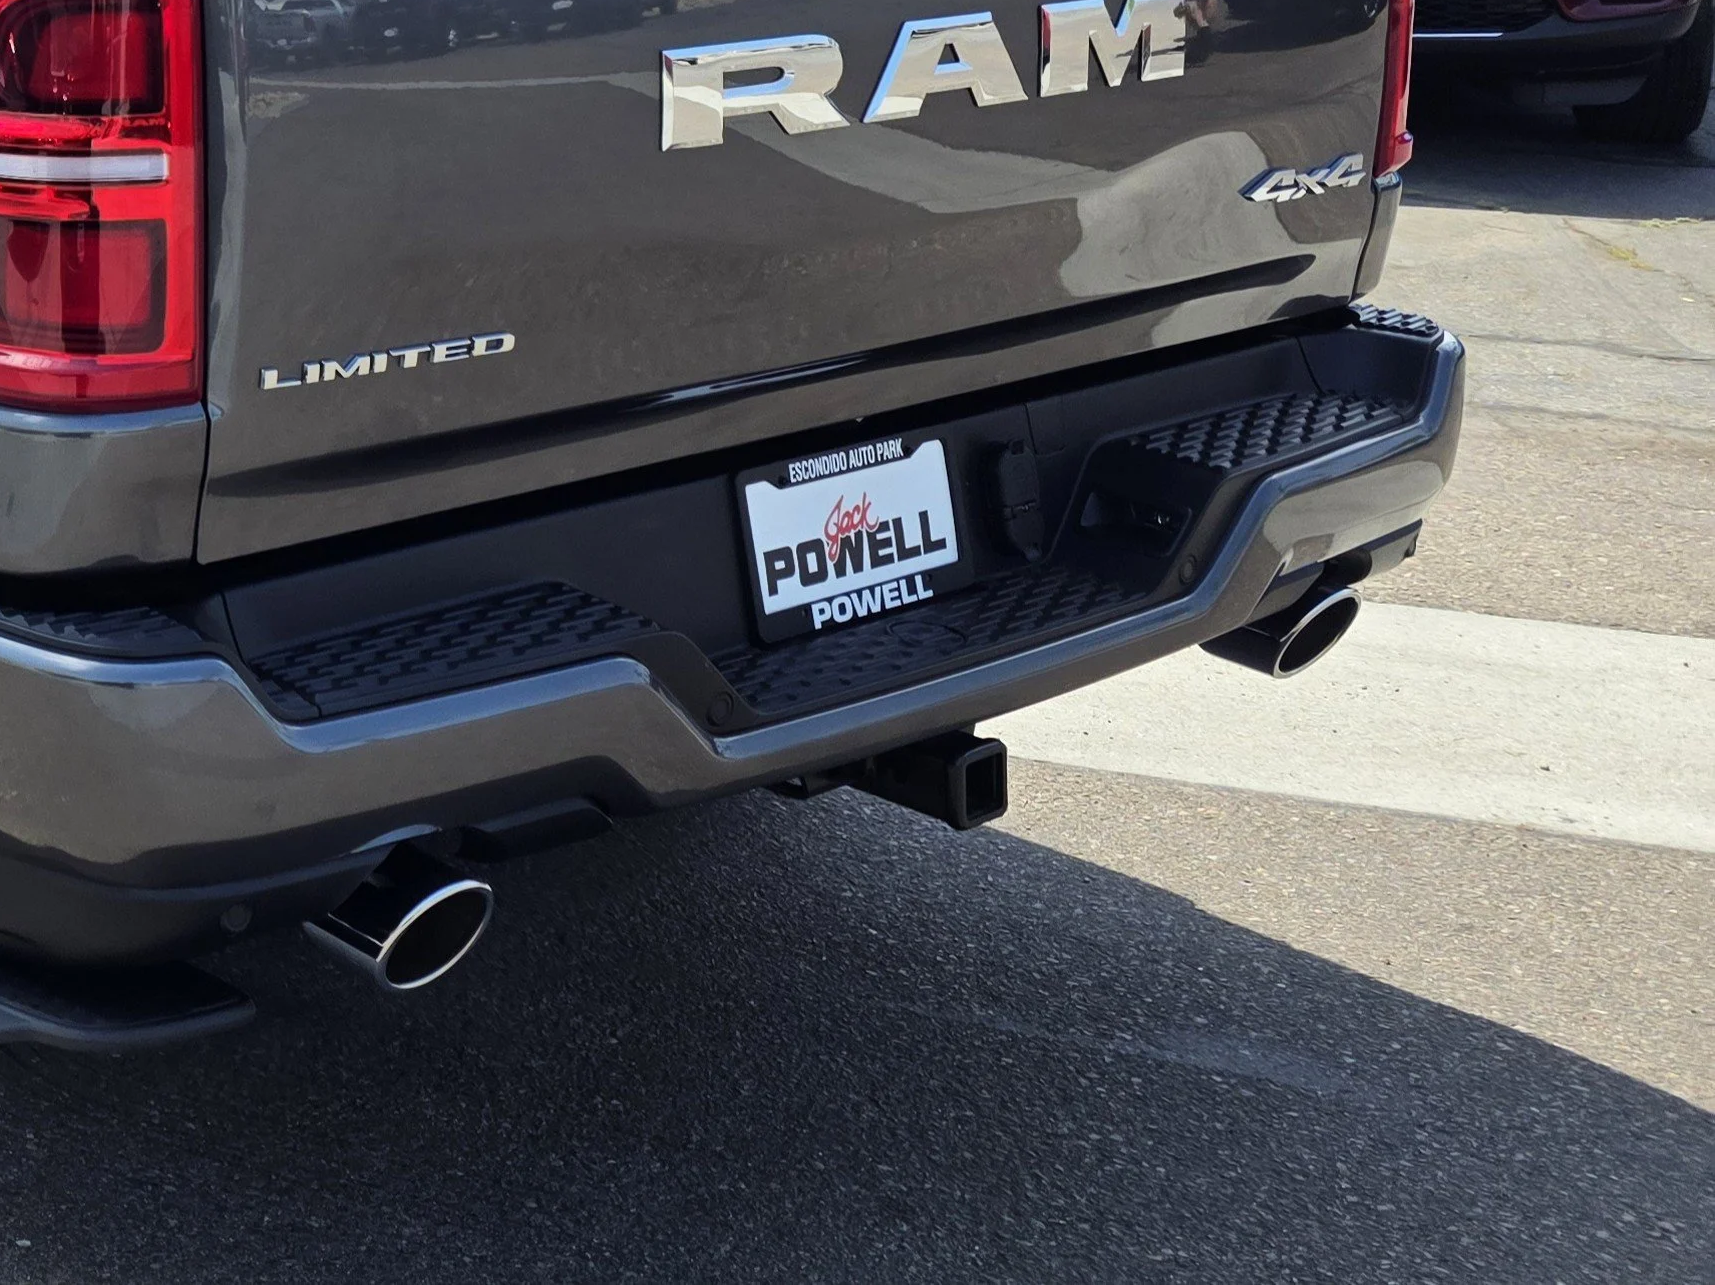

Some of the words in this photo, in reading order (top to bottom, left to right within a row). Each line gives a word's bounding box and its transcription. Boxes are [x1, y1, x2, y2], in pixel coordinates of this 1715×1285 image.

[259, 331, 516, 390] LIMITED
[789, 450, 848, 483] ESCONDIDO
[849, 444, 876, 468] AUTO
[877, 438, 904, 463] PARK
[763, 510, 947, 597] POWELL
[824, 491, 880, 563] Jack
[811, 574, 934, 630] POWELL
